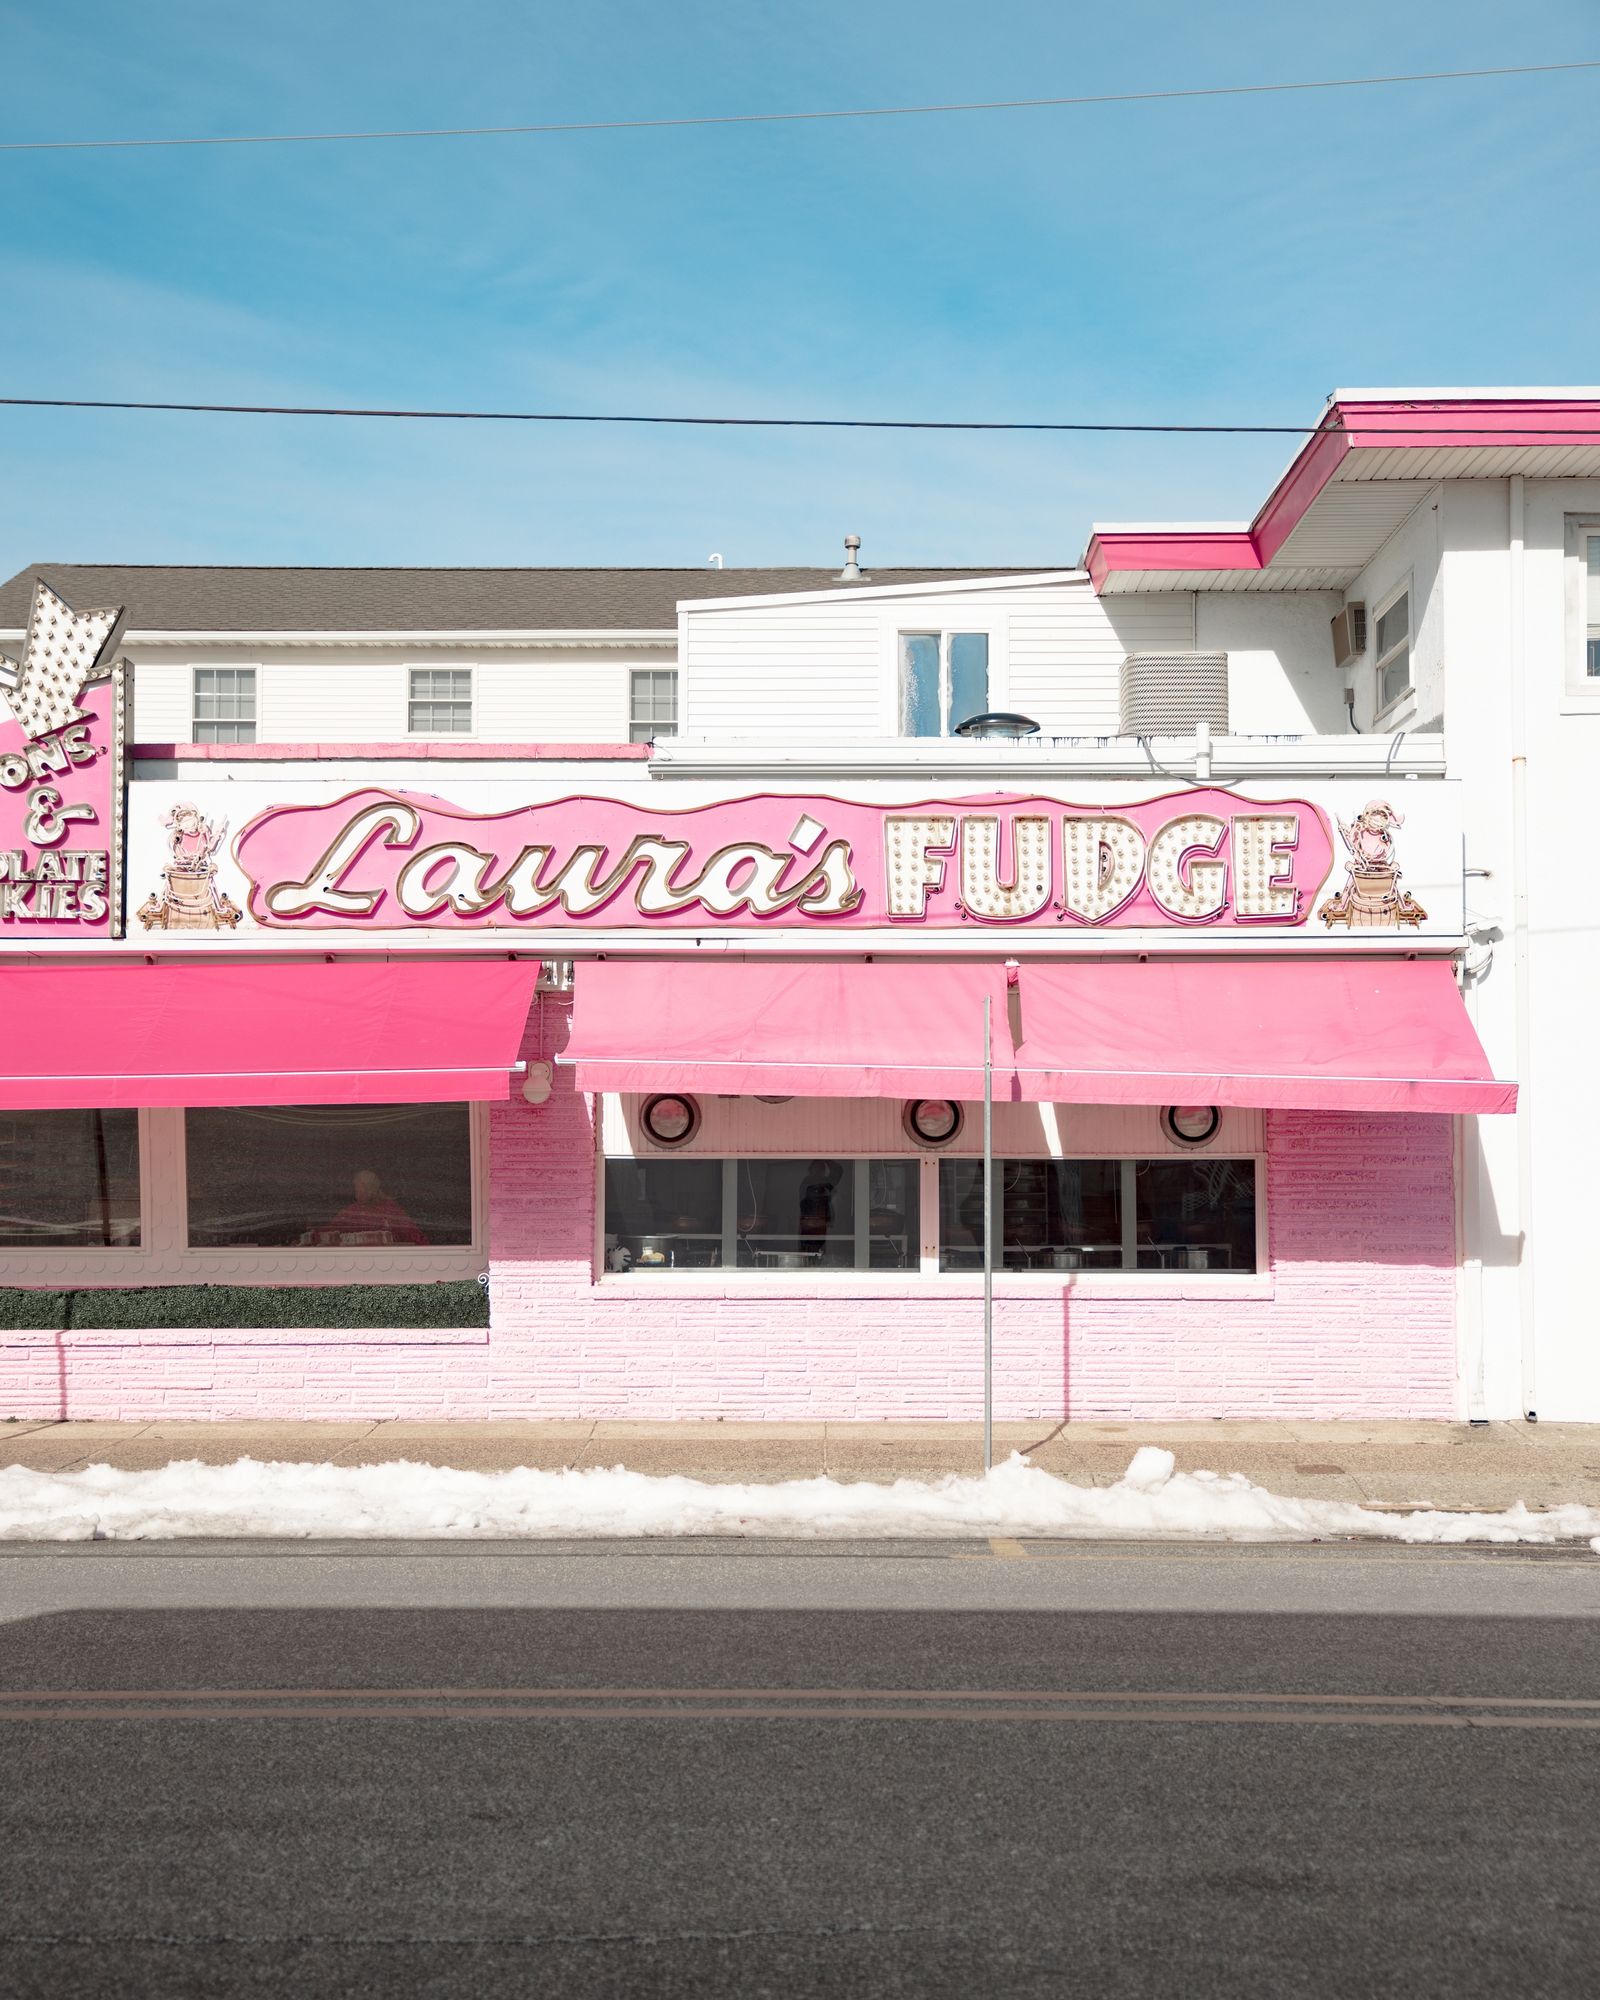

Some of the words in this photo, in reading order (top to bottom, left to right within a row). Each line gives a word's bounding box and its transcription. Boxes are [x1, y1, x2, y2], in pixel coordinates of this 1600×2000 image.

[0, 724, 97, 787] ONS
[23, 786, 96, 845] &
[264, 801, 864, 916] Laura's
[883, 813, 1302, 922] FUDGE
[0, 881, 107, 920] KIES
